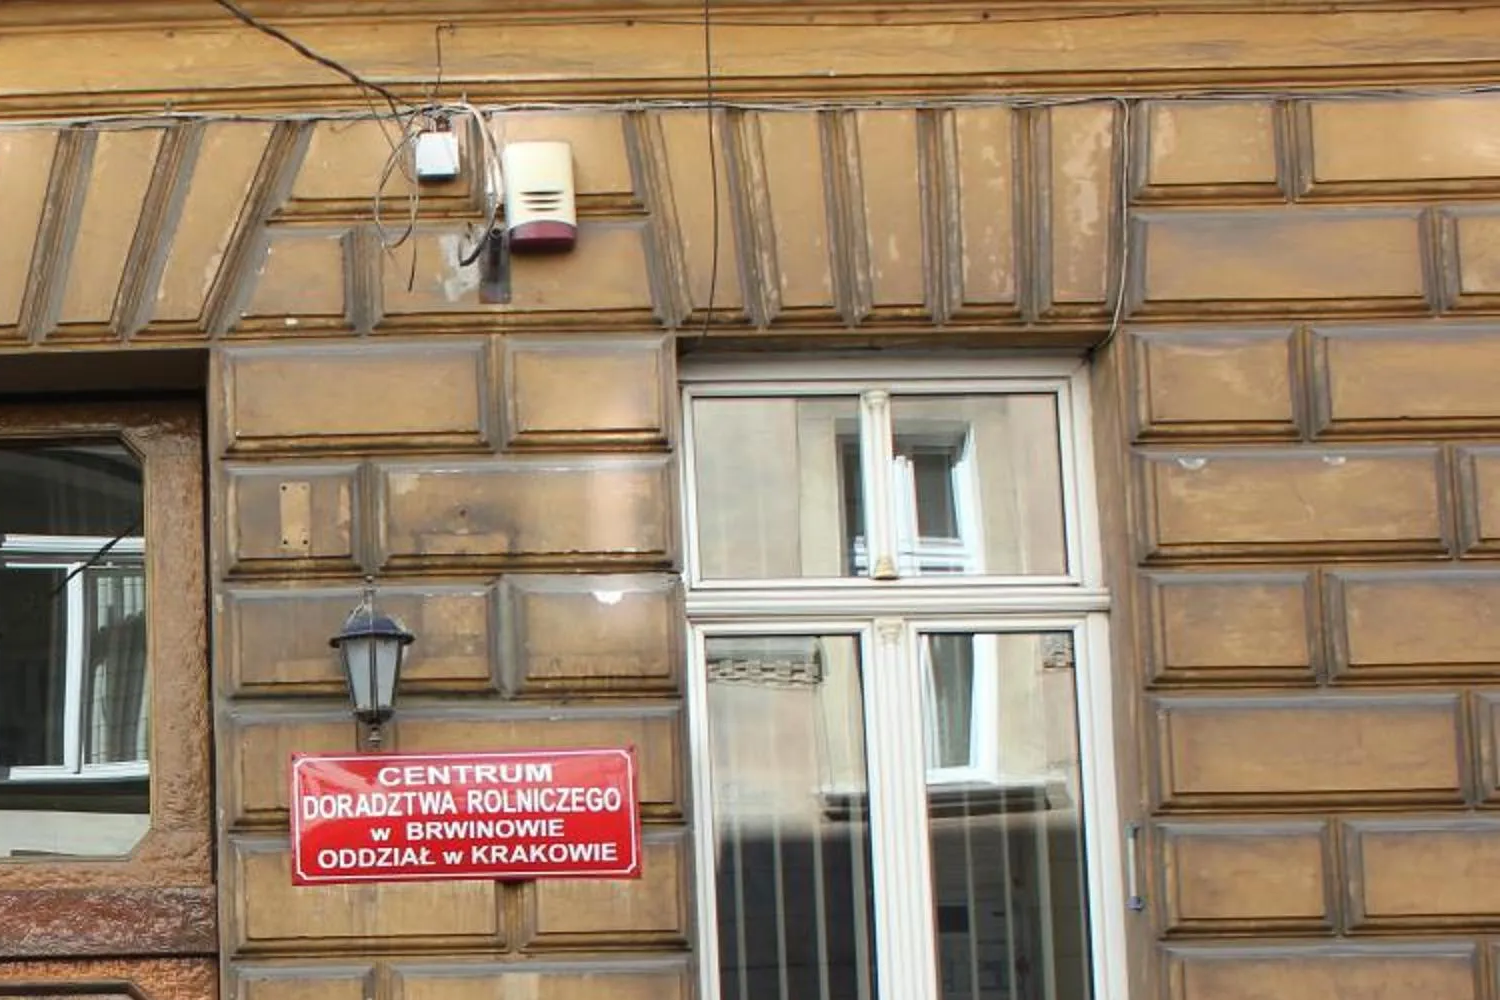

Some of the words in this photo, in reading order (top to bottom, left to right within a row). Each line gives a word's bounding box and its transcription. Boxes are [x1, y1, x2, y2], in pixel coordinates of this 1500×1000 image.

[377, 763, 553, 787] CENTRUM
[302, 793, 457, 821] DORADZTWA
[467, 787, 621, 815] ROLNICZEGO
[370, 825, 392, 841] w
[406, 818, 565, 841] BRWINOWIE
[317, 847, 436, 869] ODDZIAŁ
[443, 850, 465, 865] w
[471, 843, 618, 865] KRAKOWIE
